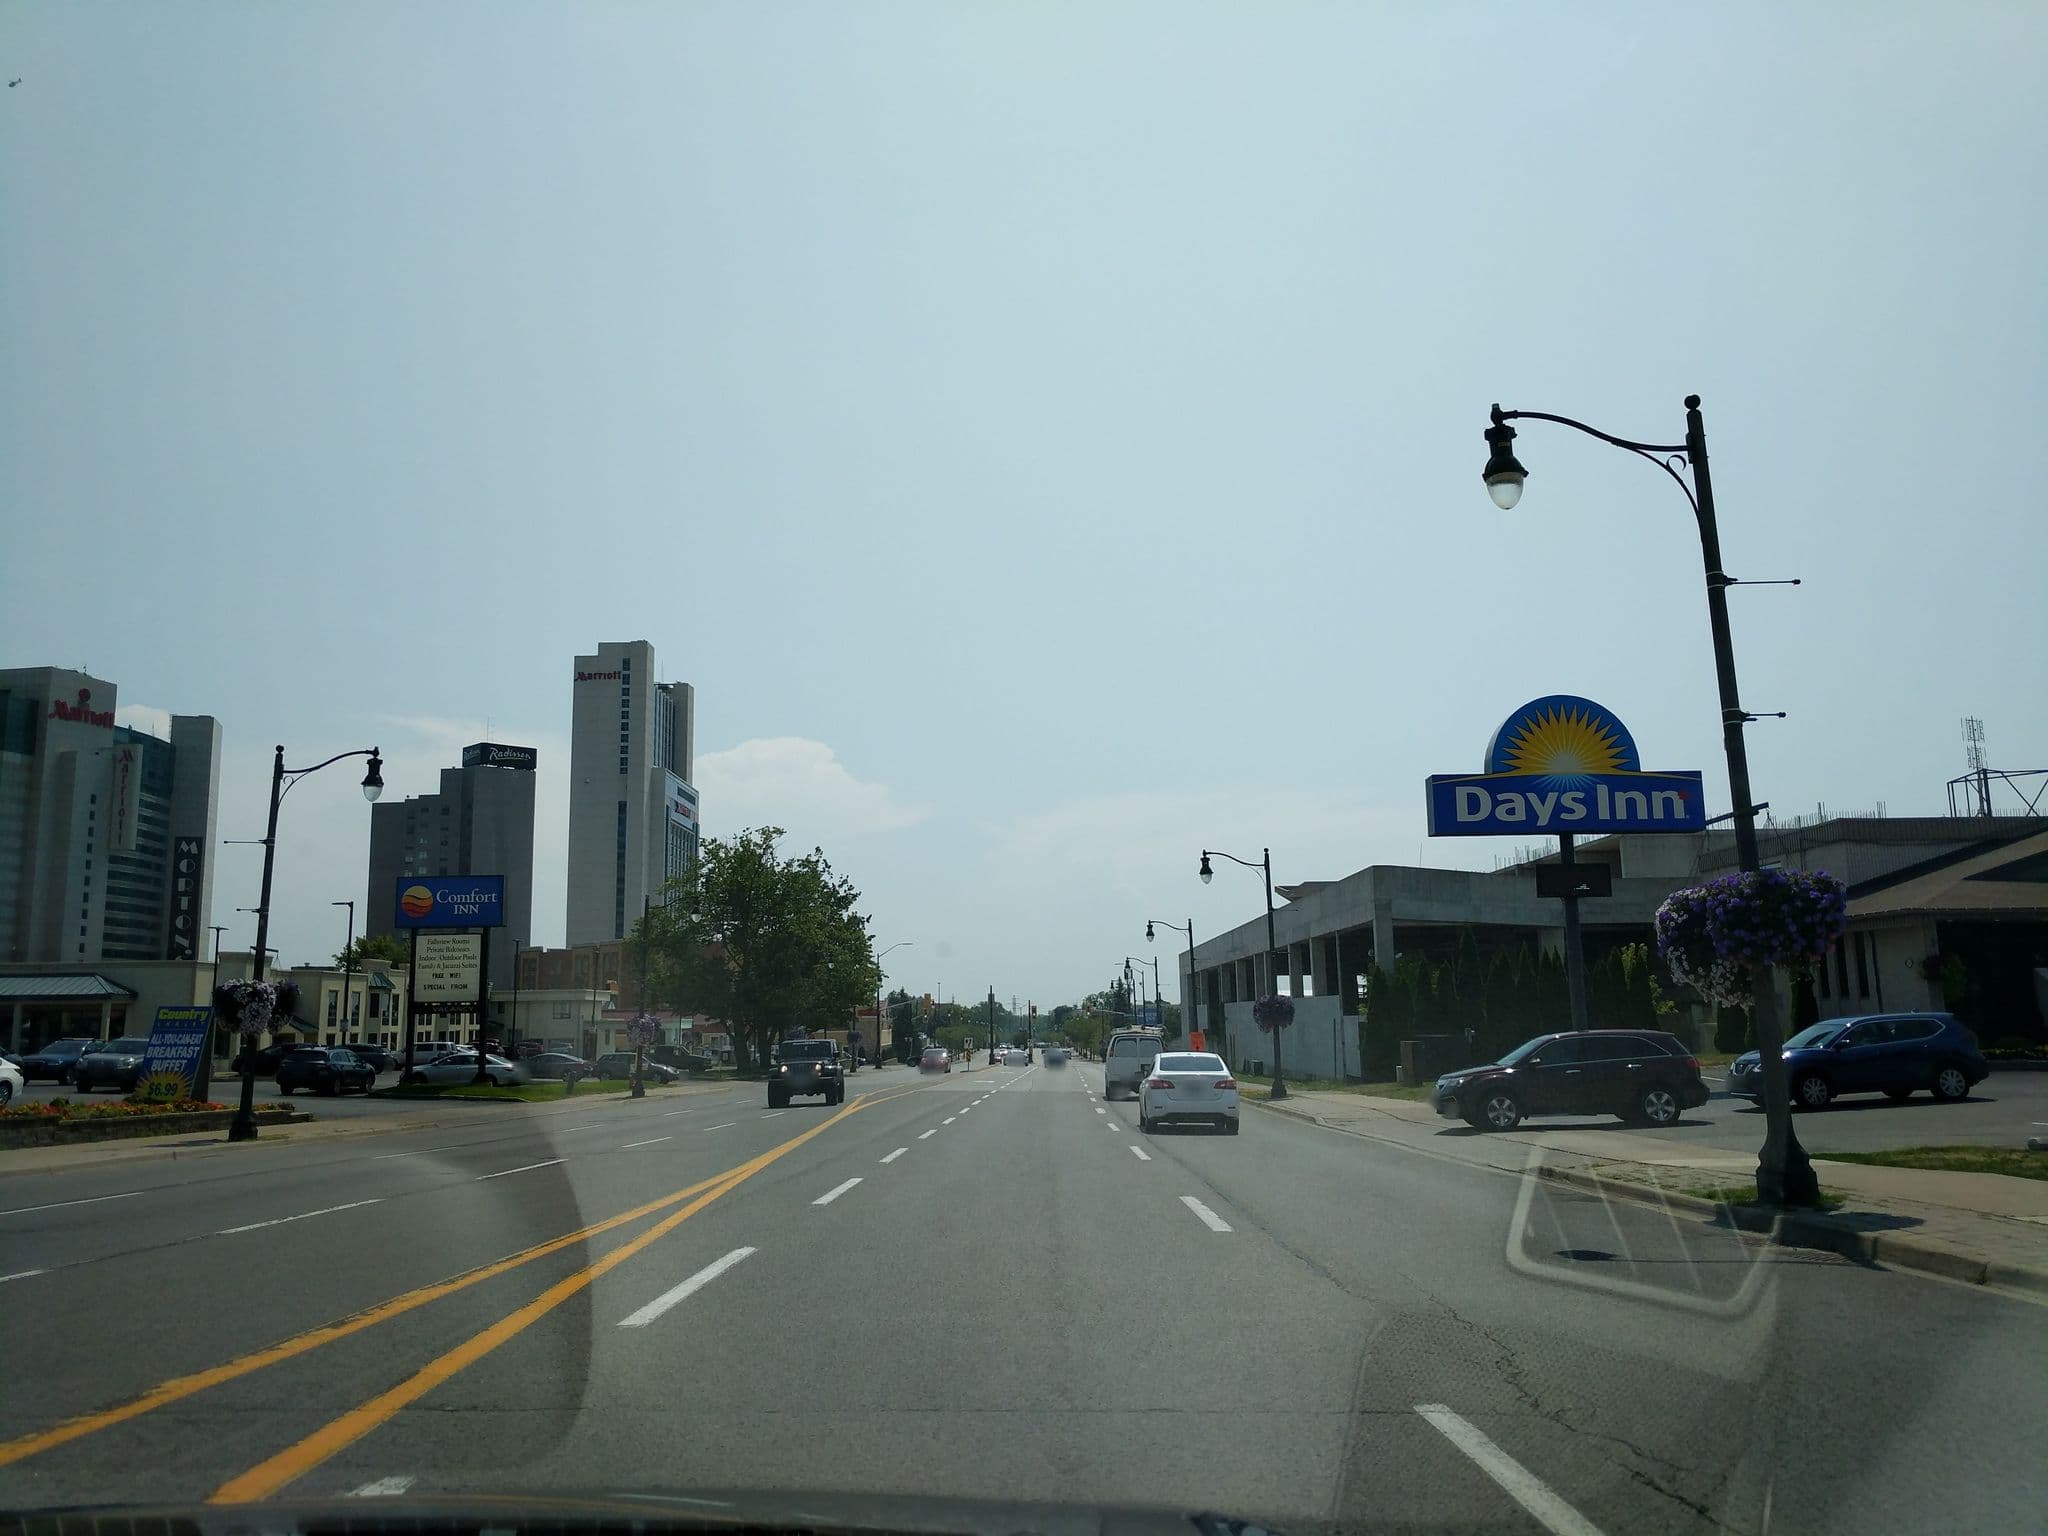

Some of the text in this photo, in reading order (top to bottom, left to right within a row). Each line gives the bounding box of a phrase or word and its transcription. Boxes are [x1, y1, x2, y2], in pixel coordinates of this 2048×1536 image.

[575, 670, 621, 682] Marriott
[490, 747, 531, 761] Radisson
[1455, 784, 1686, 826] Days Inn
[436, 888, 498, 904] Comfort
[453, 904, 480, 915] INN
[423, 983, 446, 991] SPECIAL
[158, 1009, 209, 1021] Country
[146, 1046, 200, 1059] BREAKFAST
[150, 1059, 188, 1072] BUFFET
[147, 1082, 178, 1097] $6.99
